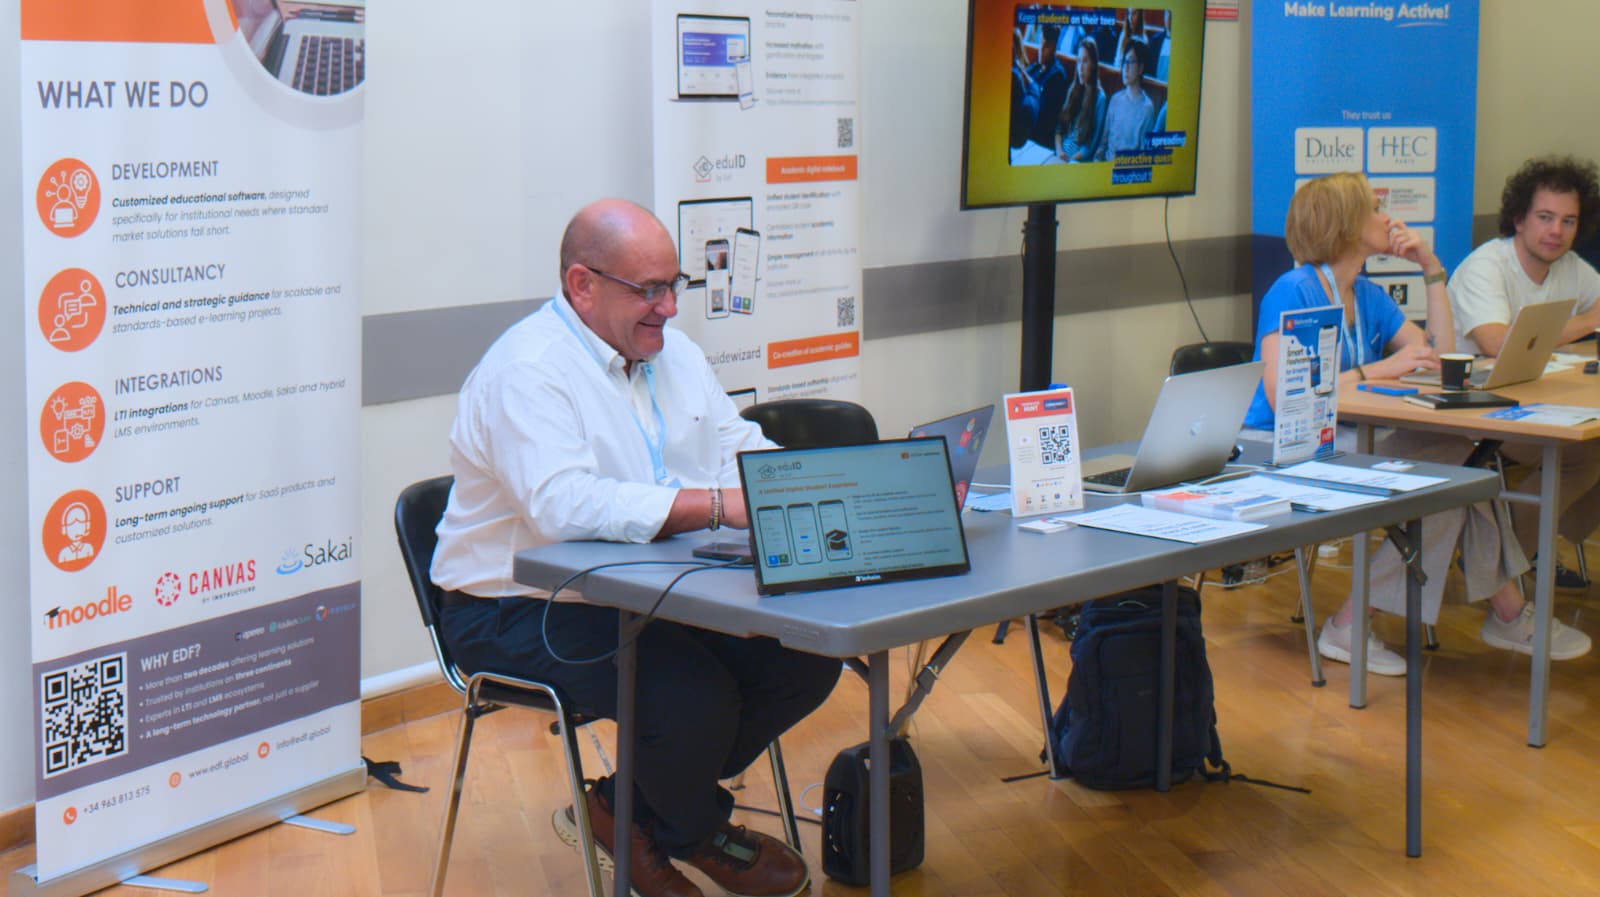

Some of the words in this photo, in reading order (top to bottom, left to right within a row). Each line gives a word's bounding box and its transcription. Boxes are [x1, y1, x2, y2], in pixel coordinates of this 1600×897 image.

[1038, 14, 1069, 24] students
[1070, 15, 1080, 24] on
[1081, 13, 1098, 24] their
[1284, 1, 1325, 17] Make
[1330, 2, 1394, 20] Learning
[1397, 3, 1449, 19] Active!
[37, 80, 116, 109] WHAT
[125, 80, 161, 108] WE
[169, 80, 209, 107] DO
[1342, 110, 1360, 120] They
[1362, 111, 1380, 120] trust
[1382, 112, 1392, 120] us
[1304, 136, 1355, 158] Duke
[1378, 135, 1428, 157] HEC
[112, 160, 218, 180] DEVELOPMENT
[715, 153, 746, 169] eduID
[112, 194, 168, 207] Customized
[170, 191, 226, 205] educational
[227, 190, 267, 202] software,
[268, 188, 310, 201] designed
[112, 211, 162, 227] specifically
[165, 210, 178, 222] for
[180, 207, 232, 220] institutional
[234, 206, 260, 217] needs
[261, 205, 286, 216] where
[288, 203, 329, 215] standard
[112, 231, 144, 242] market
[146, 227, 188, 239] solutions
[115, 263, 226, 288] CONSULTANCY
[113, 300, 160, 316] Technical
[162, 299, 182, 310] and
[184, 294, 226, 308] strategic
[228, 291, 270, 307] guidance
[271, 288, 283, 299] for
[284, 285, 323, 298] scalable
[325, 284, 342, 295] and
[112, 315, 197, 333] standards-based
[198, 309, 246, 324] e-learning
[115, 366, 223, 396] INTEGRATIONS
[114, 410, 127, 421] LTI
[129, 401, 188, 419] integrations
[190, 399, 203, 410] for
[298, 382, 318, 393] and
[319, 378, 346, 393] hybrid
[113, 425, 132, 439] LMS
[134, 416, 200, 435] environments.
[115, 476, 181, 503] SUPPORT
[115, 509, 168, 528] Long-term
[169, 502, 207, 518] ongoing
[209, 493, 244, 510] support
[246, 490, 257, 501] for
[281, 480, 315, 497] products
[317, 475, 336, 488] and
[115, 526, 170, 545] customized
[172, 517, 213, 534] solutions.
[303, 536, 352, 568] Sakai
[189, 559, 256, 595] CANVAS
[46, 585, 132, 630] moodle
[141, 651, 169, 672] WHY
[172, 643, 202, 664] EDF?
[145, 680, 164, 691] More
[165, 674, 183, 685] than
[184, 670, 198, 680] two
[199, 661, 230, 676] decades
[231, 654, 257, 667] offering
[145, 692, 173, 706] Trusted
[174, 690, 184, 700] by
[235, 669, 254, 680] three
[255, 659, 292, 675] continents
[145, 709, 172, 723] Experts
[172, 705, 180, 715] in
[181, 702, 193, 713] LTI
[145, 730, 152, 739] A
[152, 719, 192, 736] long-term
[192, 706, 233, 725] technology
[188, 752, 249, 779] www.edf.global
[83, 801, 99, 815] +34
[101, 796, 117, 809] 963
[118, 790, 134, 804] 813
[135, 785, 151, 798] 575
